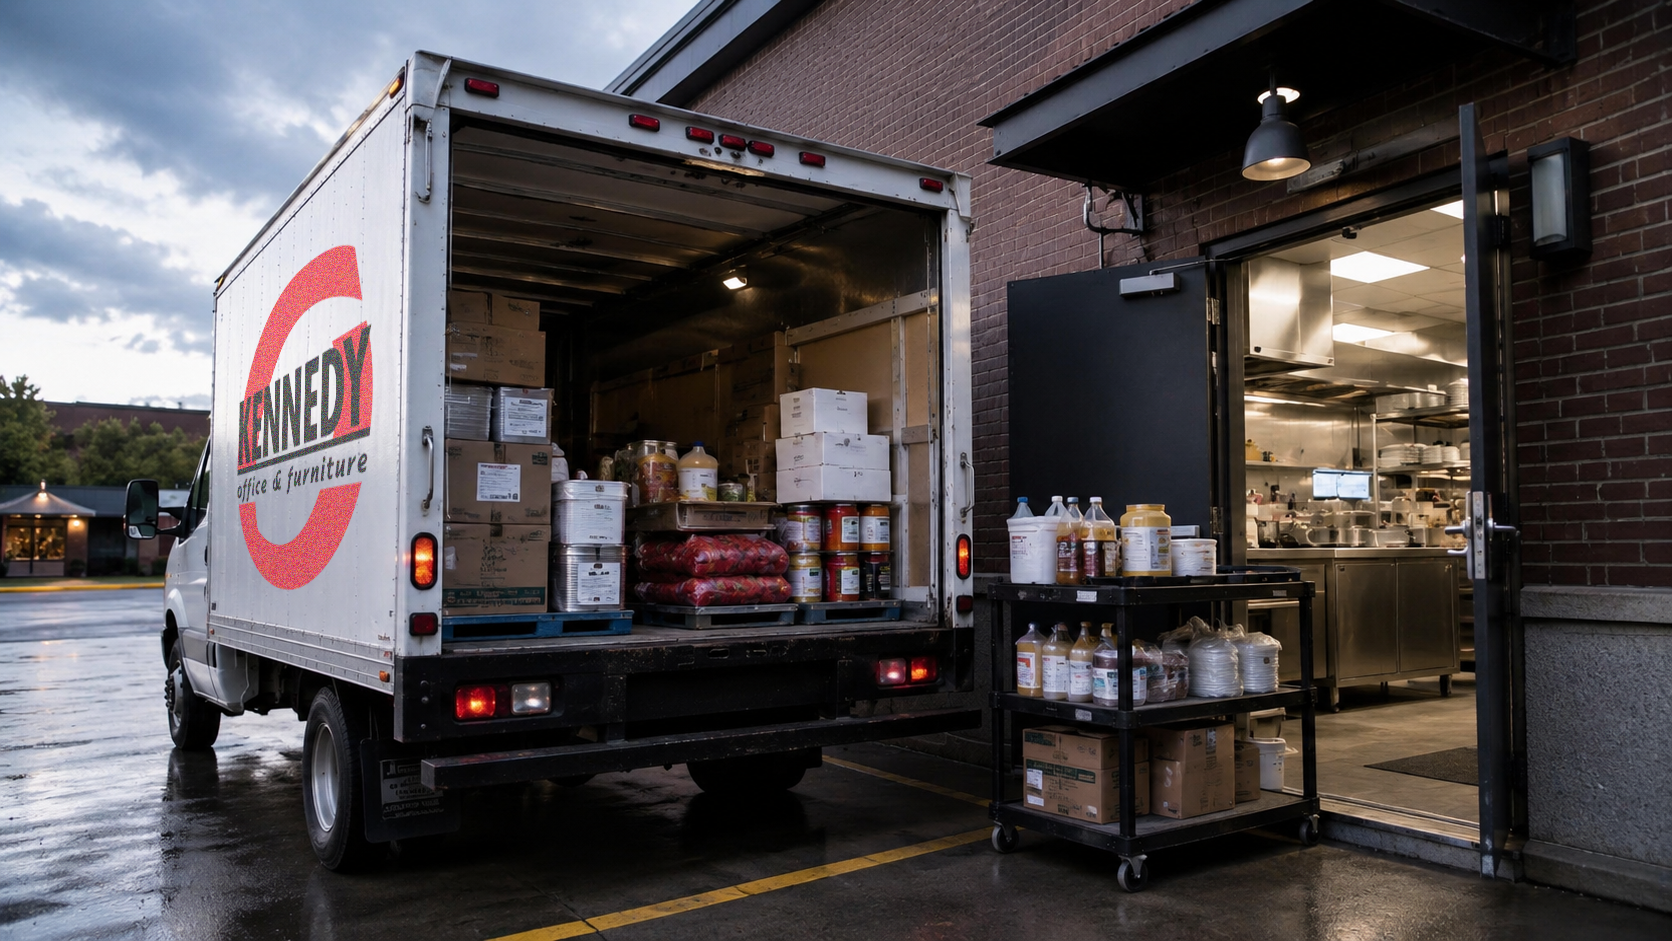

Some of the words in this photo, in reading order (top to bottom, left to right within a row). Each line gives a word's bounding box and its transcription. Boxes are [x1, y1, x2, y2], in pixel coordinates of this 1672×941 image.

[238, 324, 371, 466] KENNEDY
[237, 475, 267, 503] office
[272, 469, 281, 491] &
[286, 453, 368, 495] furniture
